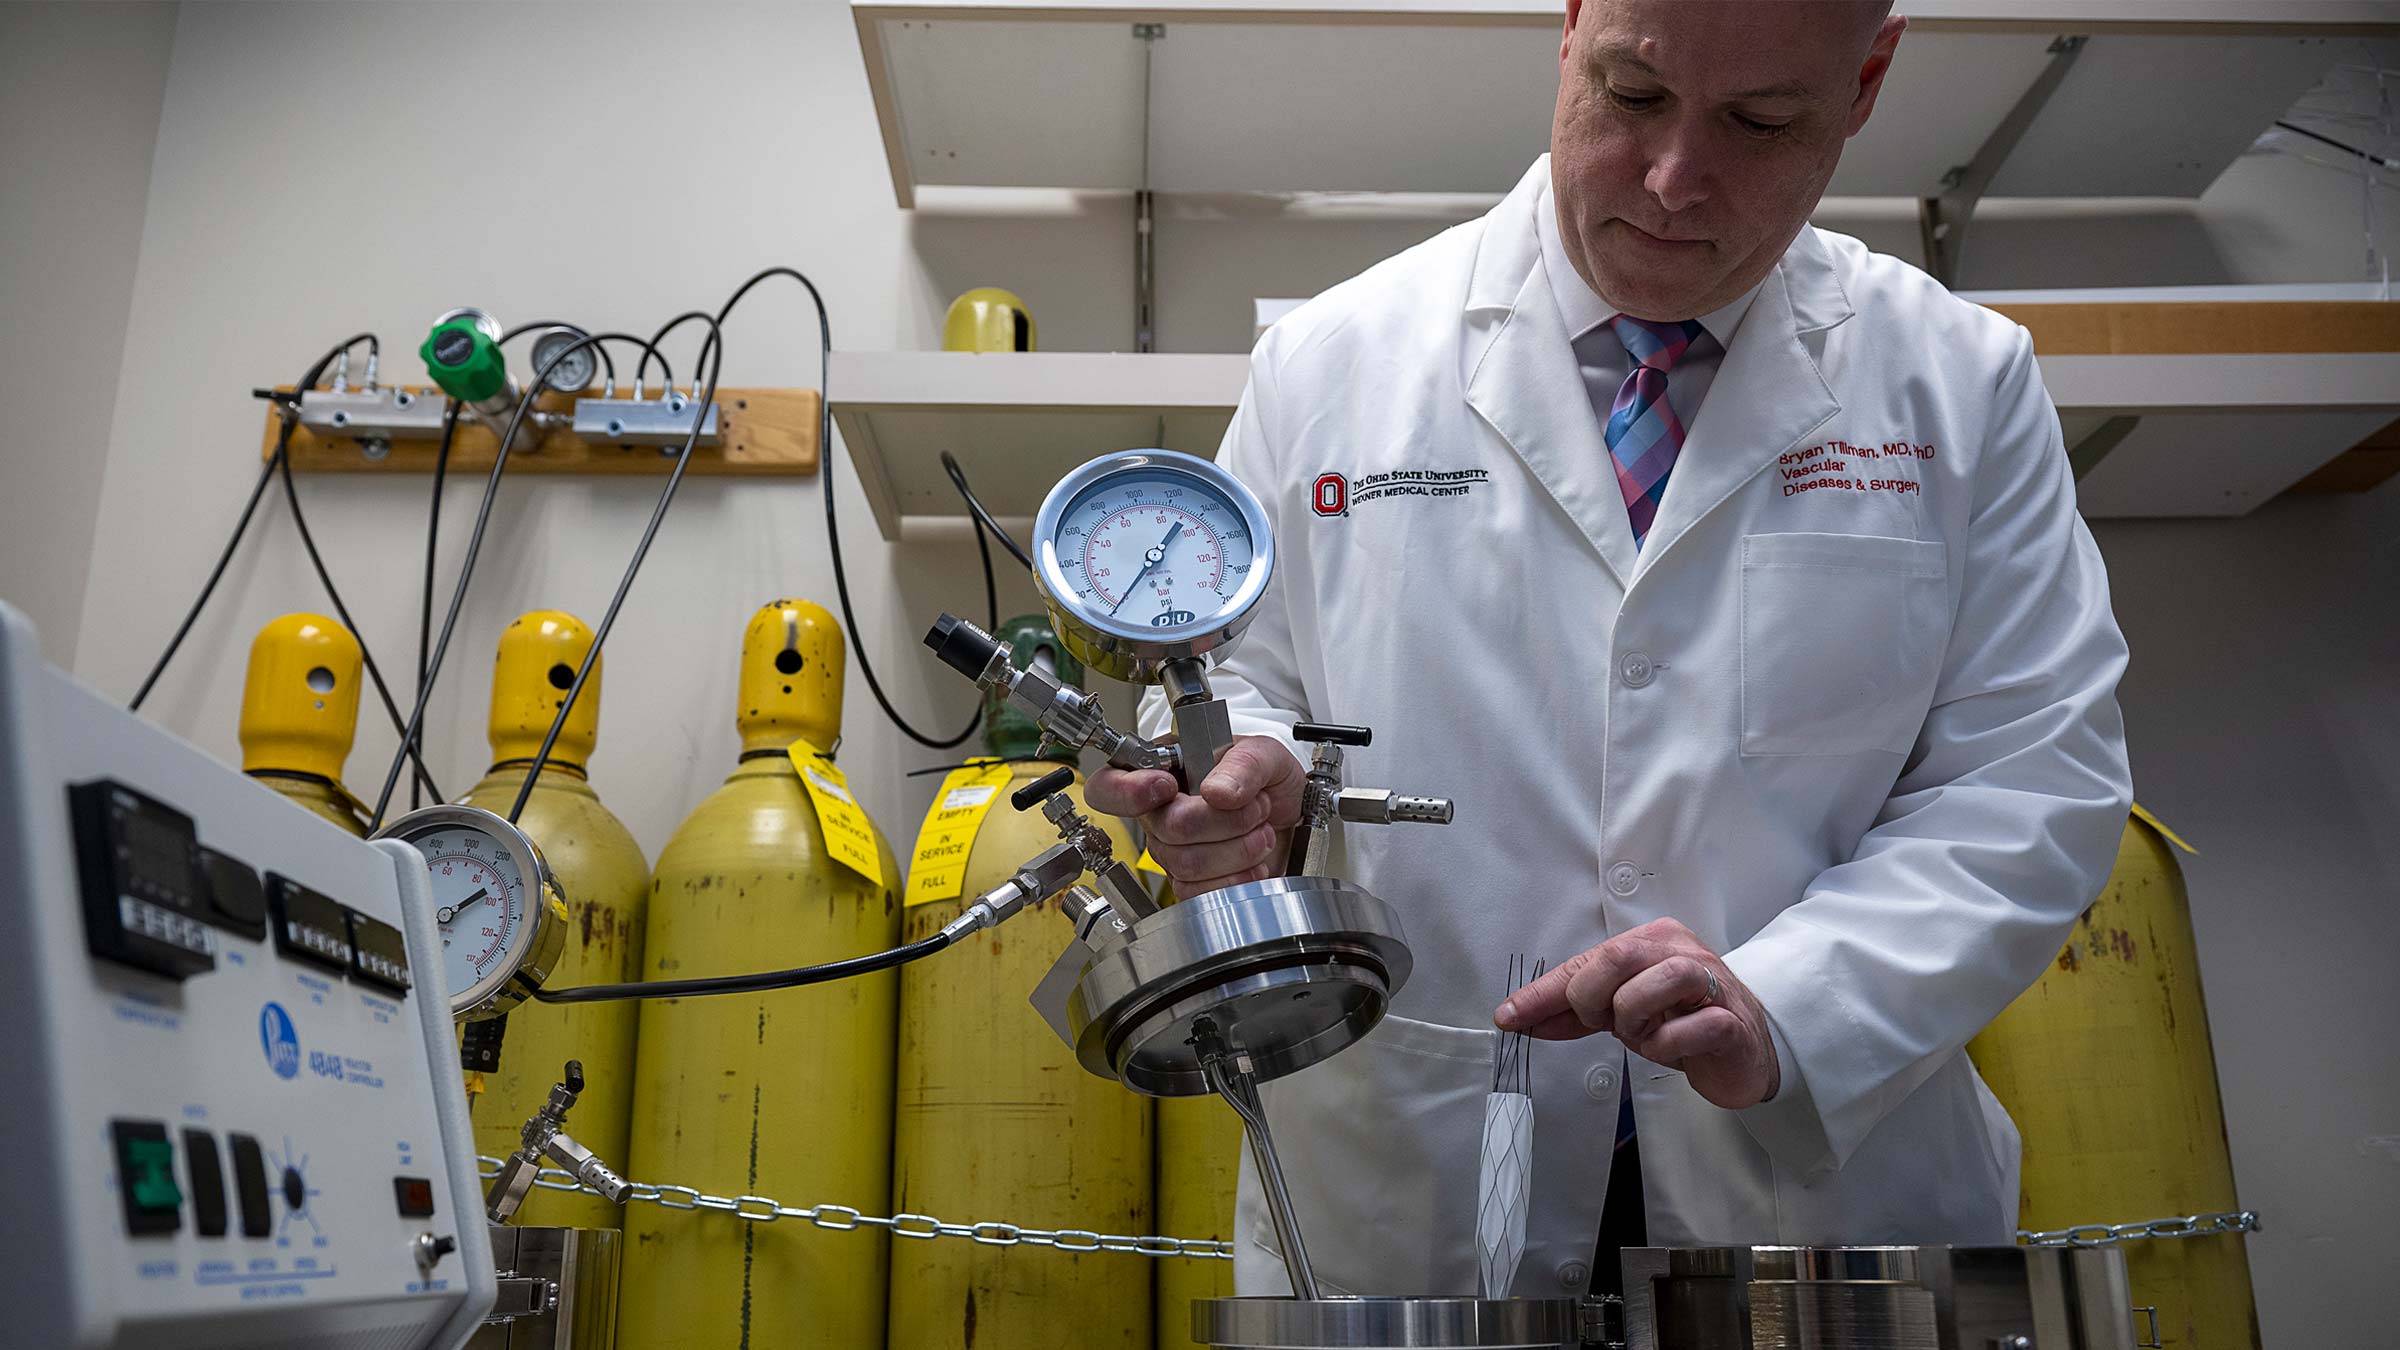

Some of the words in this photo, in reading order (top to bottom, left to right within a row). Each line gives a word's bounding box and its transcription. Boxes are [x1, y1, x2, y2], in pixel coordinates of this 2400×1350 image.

[1779, 445, 1824, 465] Bryan
[1425, 469, 1488, 481] UNIVERSITY
[1781, 458, 1846, 481] Vascular
[1783, 477, 1852, 497] Diseases
[1856, 479, 1866, 491] &
[1870, 479, 1920, 496] Surgery
[1125, 489, 1144, 498] 1000
[1164, 488, 1183, 498] 1200
[1351, 490, 1382, 506] WEXNER
[1384, 487, 1428, 498] MEDICAL
[1431, 486, 1470, 497] CENTER
[1090, 501, 1105, 511] 800
[1200, 503, 1219, 512] 1400
[1120, 518, 1132, 529] 60
[1156, 515, 1167, 526] 80
[1065, 526, 1081, 537] 600
[1182, 528, 1196, 538] 100
[1226, 529, 1245, 541] 1600
[1100, 539, 1112, 549] 40
[1196, 553, 1211, 564] 120
[1099, 567, 1111, 577] 20
[1197, 581, 1208, 589] 137
[1157, 588, 1170, 596] bar
[1160, 595, 1173, 608] psi
[937, 807, 976, 822] EMPTY
[429, 838, 444, 849] 800
[463, 838, 479, 849] 1000
[939, 834, 952, 844] IN
[495, 850, 511, 861] 1200
[919, 842, 965, 861] SERVICE
[442, 866, 453, 877] 60
[472, 874, 482, 884] 80
[921, 874, 947, 889] FULL
[485, 897, 497, 907] 100
[481, 927, 494, 937] 120
[309, 1051, 344, 1080] 4848
